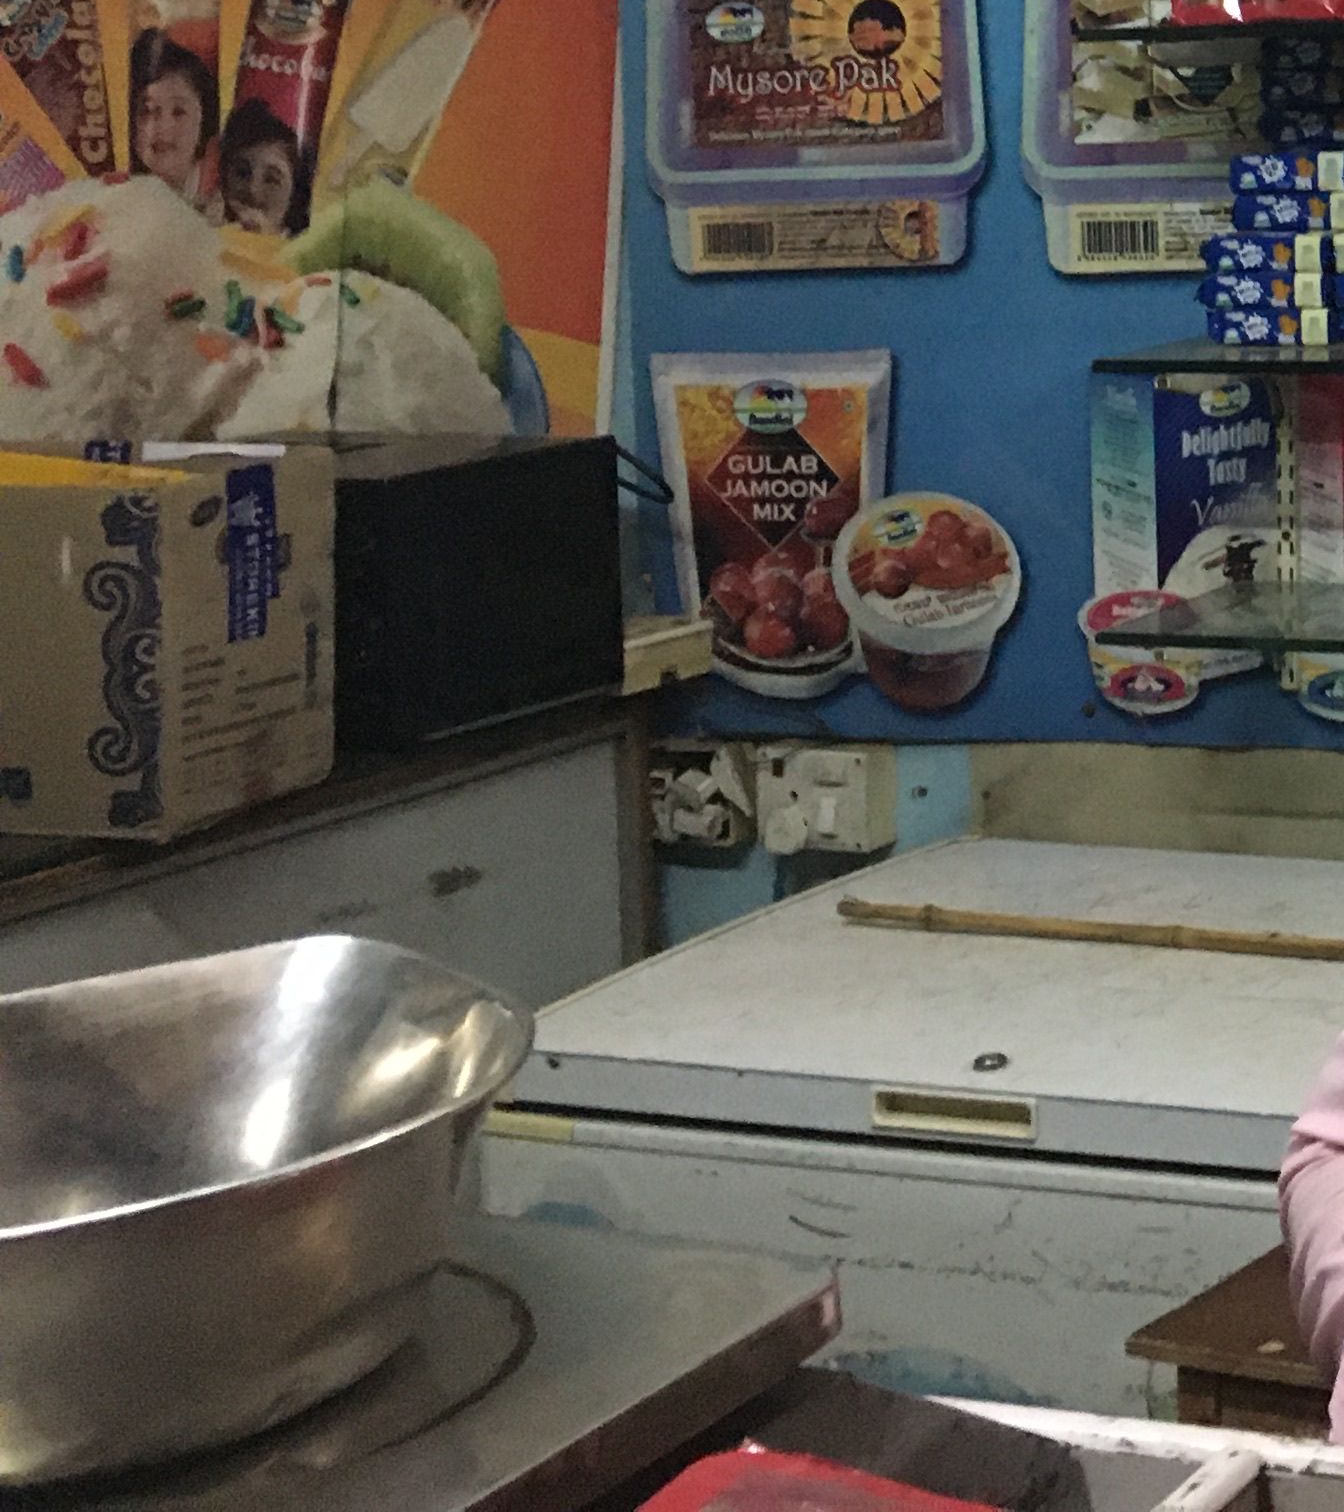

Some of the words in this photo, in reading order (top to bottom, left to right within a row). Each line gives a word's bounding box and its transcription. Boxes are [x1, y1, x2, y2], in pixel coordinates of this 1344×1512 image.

[708, 63, 830, 104] Mysore
[726, 453, 819, 475] GULAB
[721, 478, 828, 498] JAMOON
[752, 502, 797, 522] MIX
